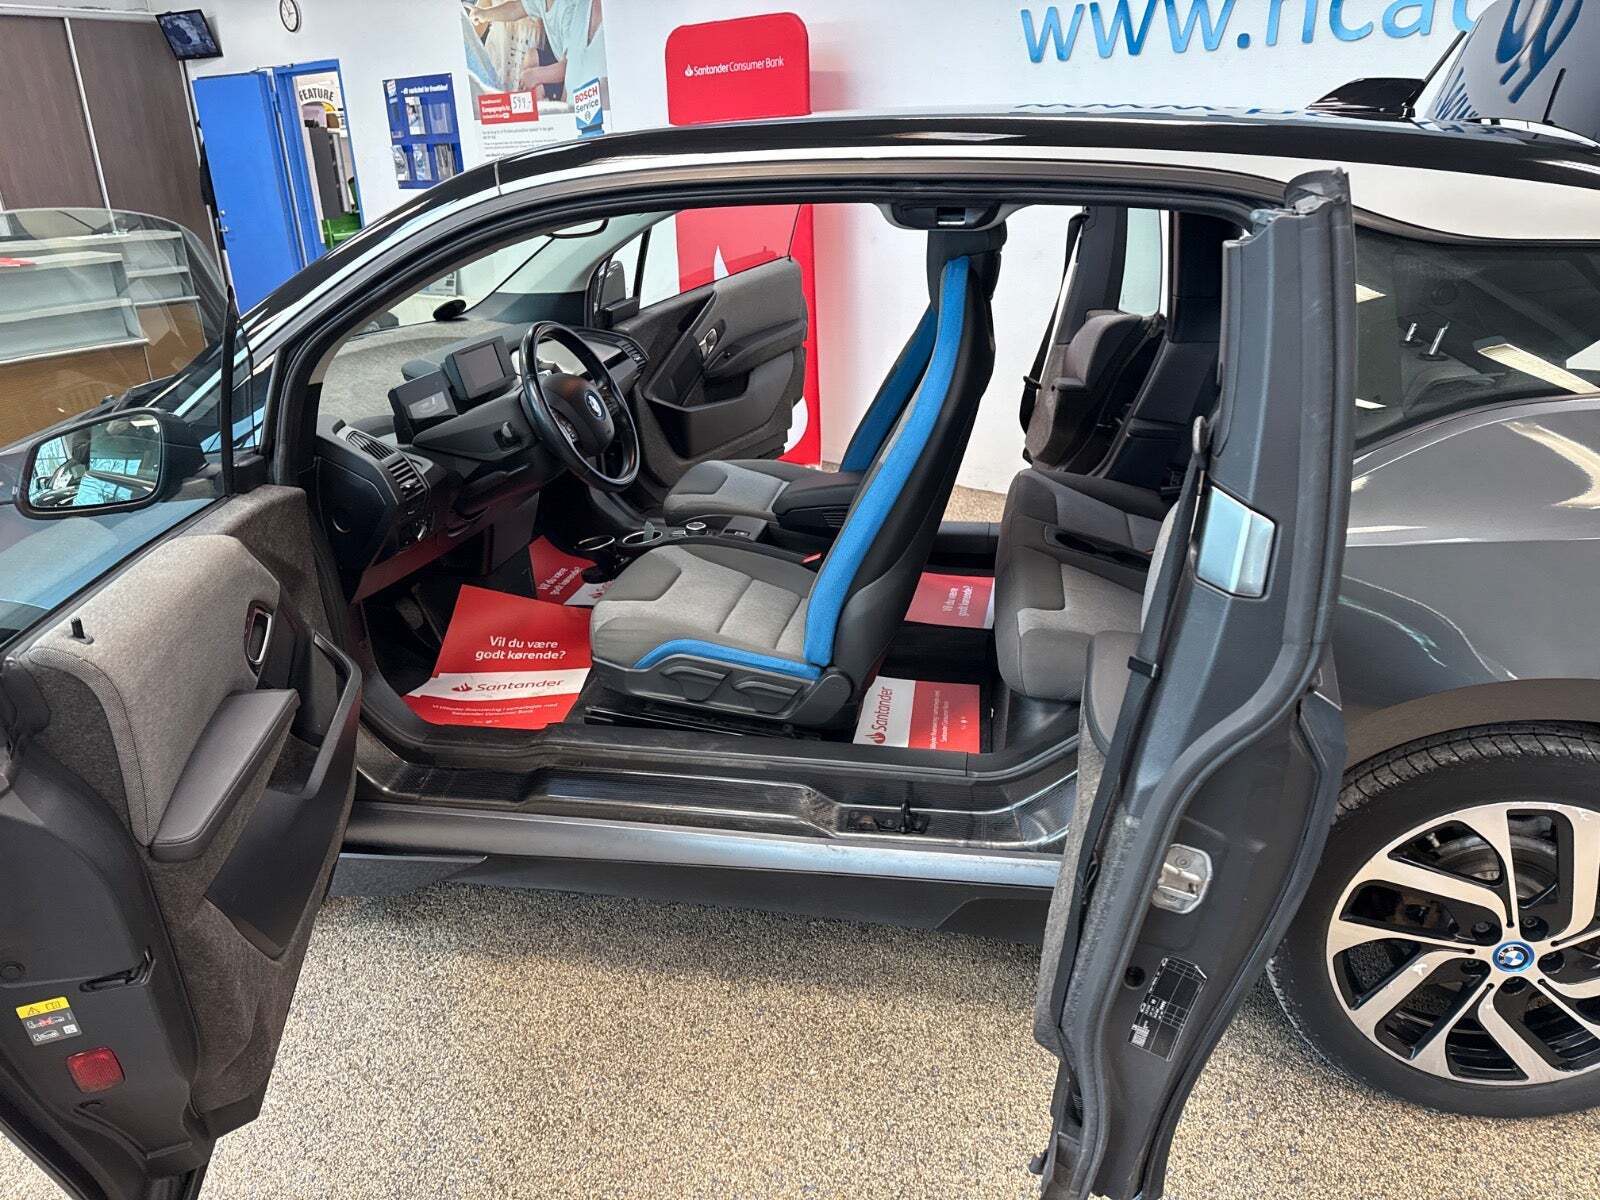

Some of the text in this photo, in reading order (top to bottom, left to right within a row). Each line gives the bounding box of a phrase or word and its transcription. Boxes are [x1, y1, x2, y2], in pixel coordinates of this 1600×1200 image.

[694, 56, 784, 76] Santander Consumer Bank
[299, 88, 334, 101] FEATURE
[575, 86, 598, 105] BOSCH
[576, 98, 599, 113] Service
[490, 635, 559, 649] Vil du være
[475, 649, 566, 661] godt kørende?
[475, 679, 564, 692] Santander
[872, 686, 893, 732] Santander
